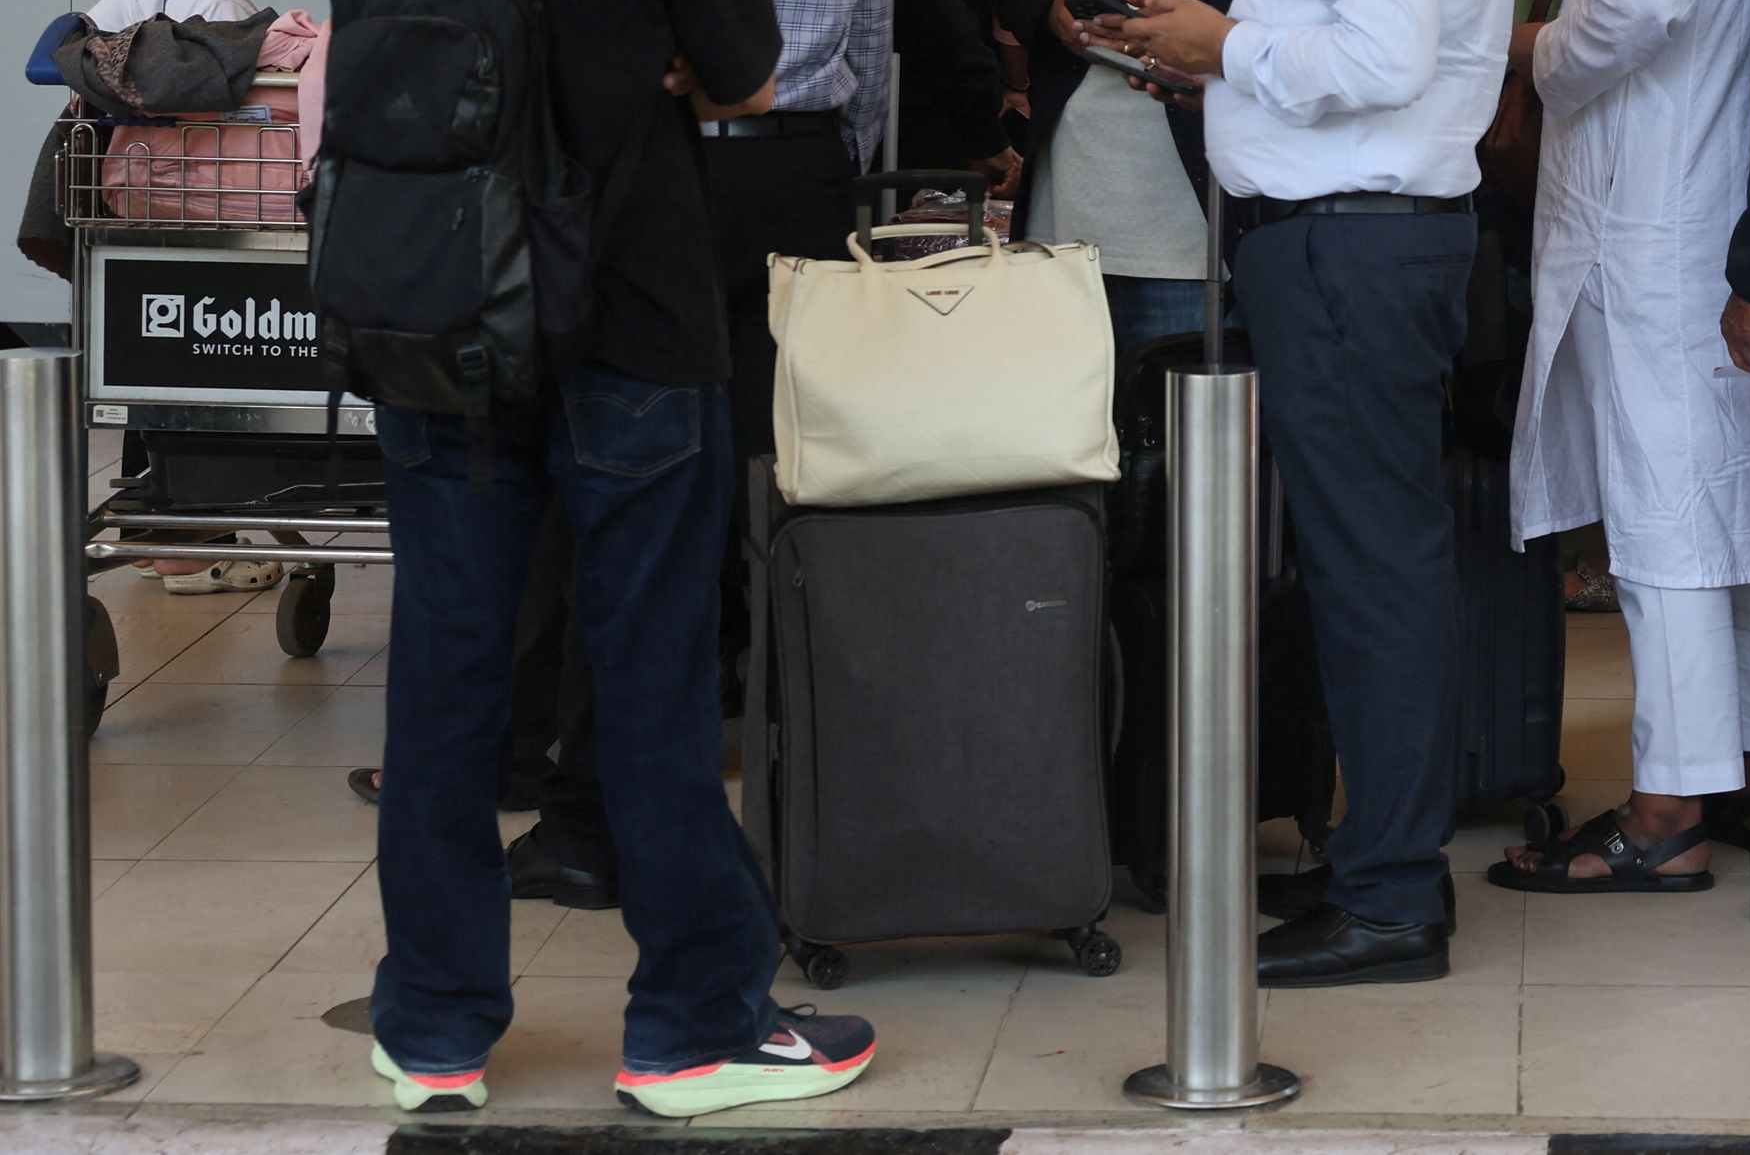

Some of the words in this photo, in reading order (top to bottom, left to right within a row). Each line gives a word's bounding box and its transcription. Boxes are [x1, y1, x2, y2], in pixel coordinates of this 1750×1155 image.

[192, 296, 317, 341] Goldm
[192, 343, 254, 357] SWITCH
[260, 345, 281, 357] TO
[289, 346, 318, 358] THE
